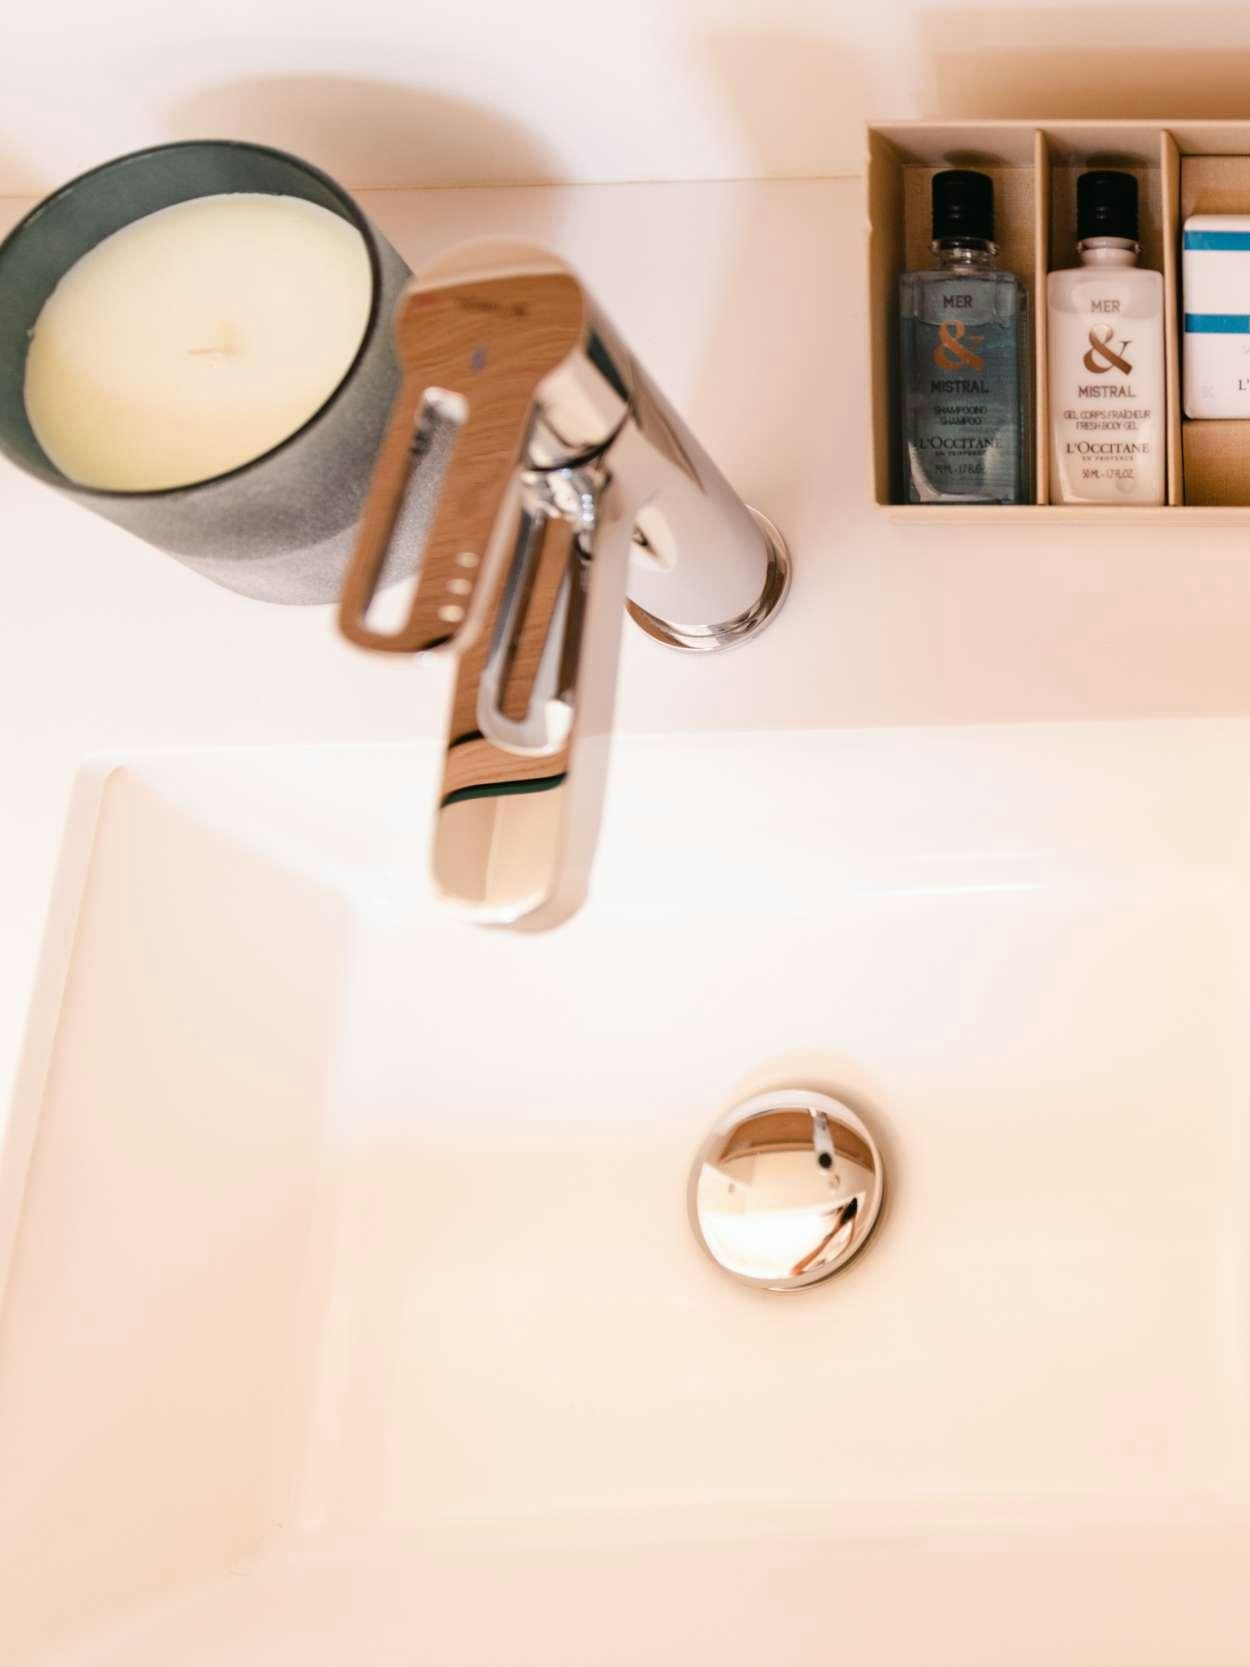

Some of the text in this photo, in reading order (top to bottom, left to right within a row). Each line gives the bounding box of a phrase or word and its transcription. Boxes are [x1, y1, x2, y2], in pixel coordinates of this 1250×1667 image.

[943, 295, 973, 308] MER
[1091, 301, 1120, 313] MER
[933, 319, 985, 373] &
[1082, 323, 1133, 376] &
[930, 381, 989, 394] MISTRAL
[1078, 385, 1136, 398] MISTRAL
